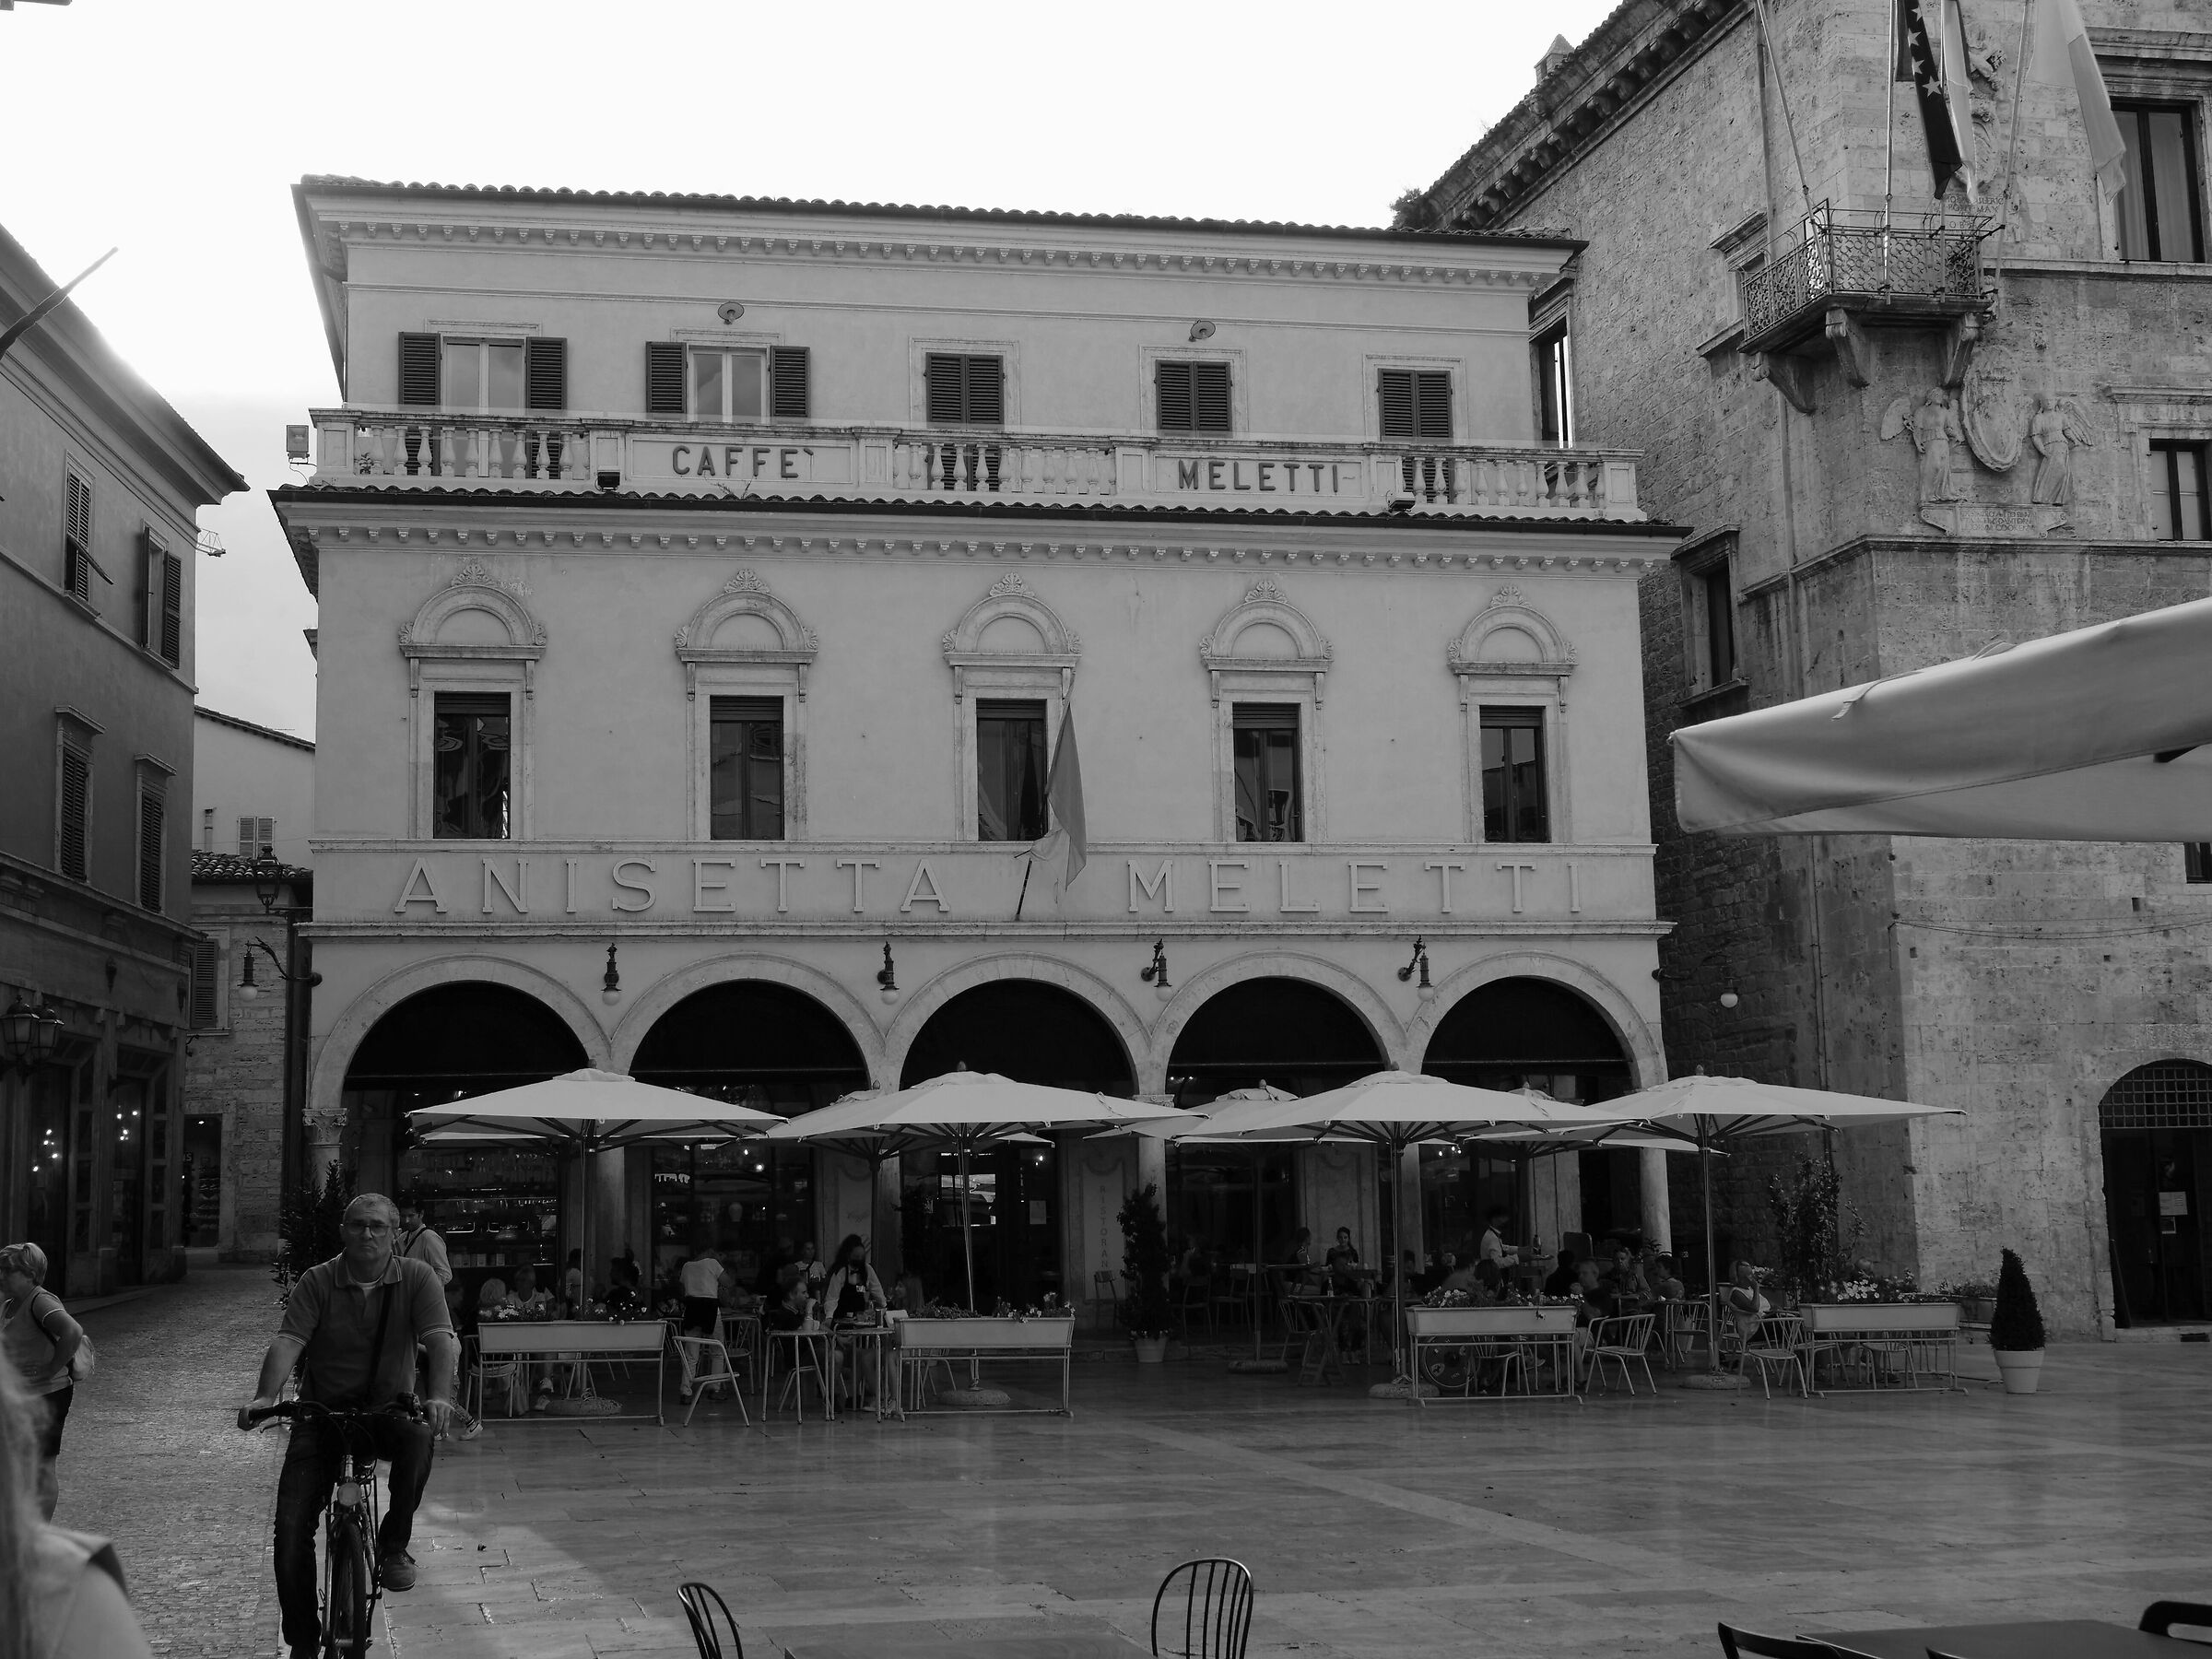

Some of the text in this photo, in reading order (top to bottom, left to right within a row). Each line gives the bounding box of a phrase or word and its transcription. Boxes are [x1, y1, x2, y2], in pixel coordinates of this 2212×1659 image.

[1178, 460, 1338, 493] MELETTI
[394, 857, 1581, 912] ANISETTA MELETTI
